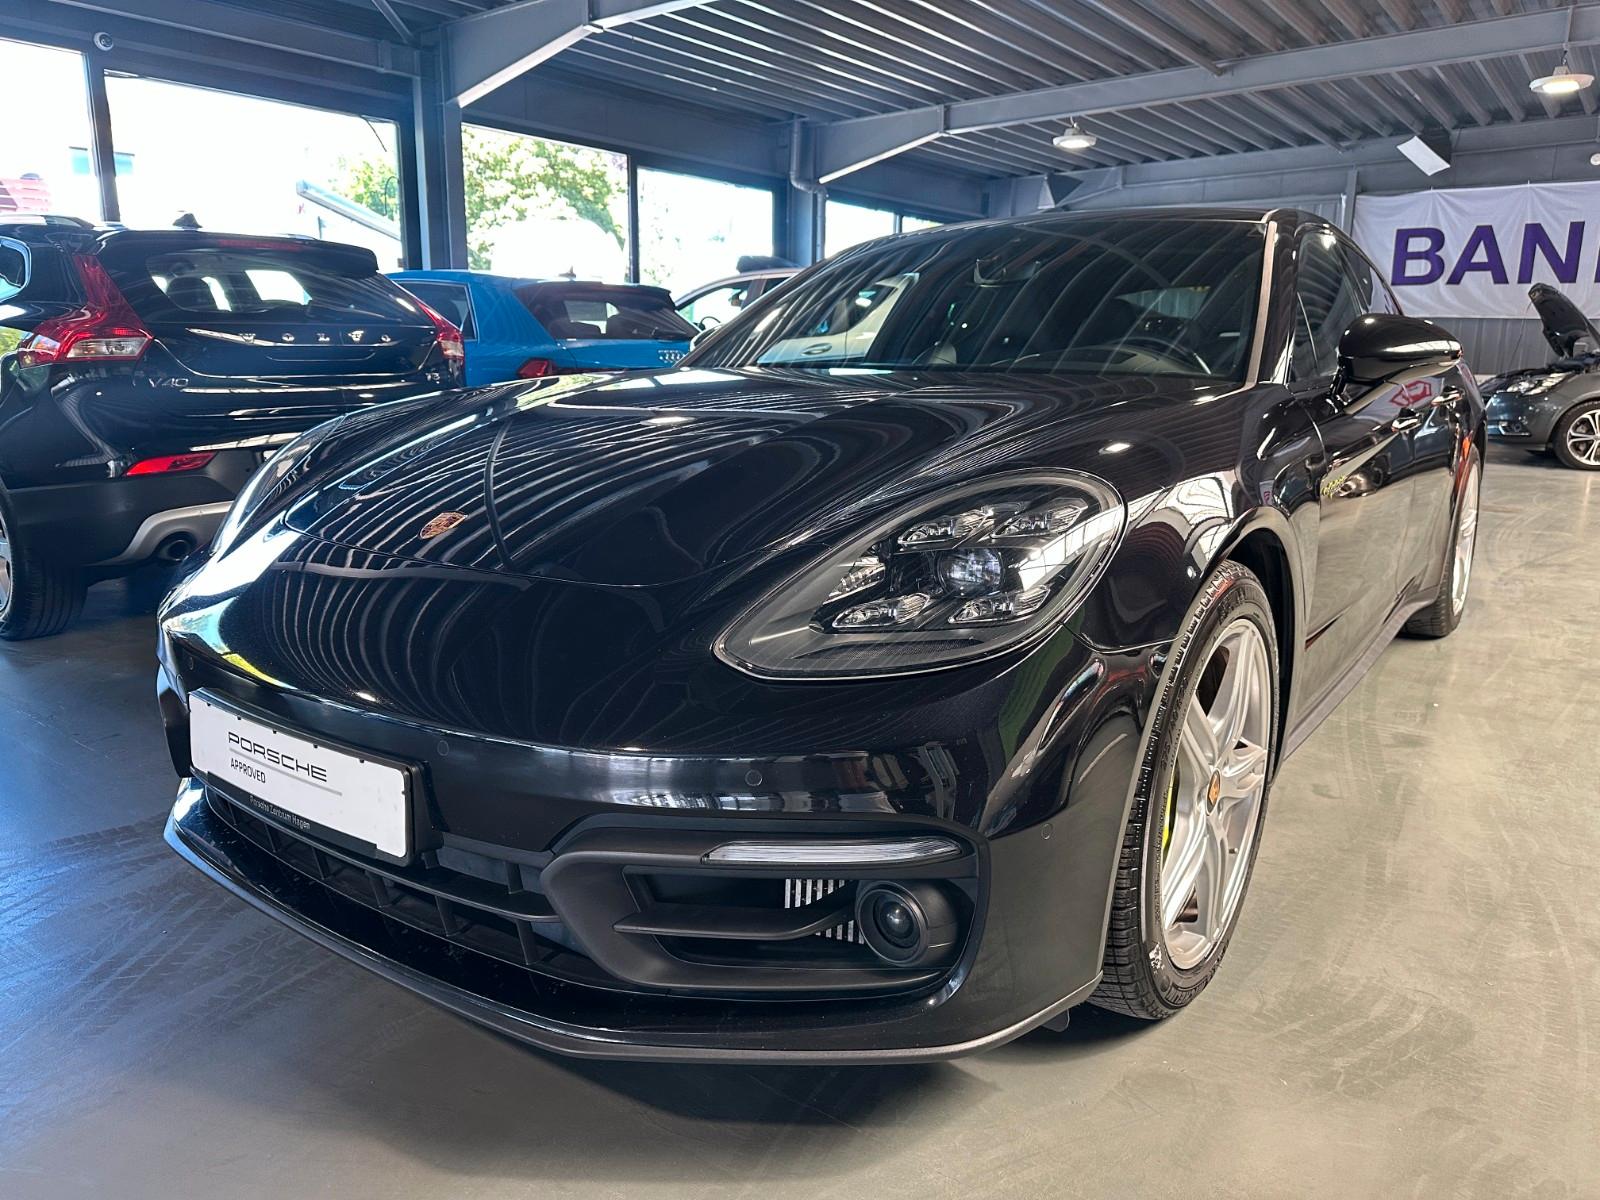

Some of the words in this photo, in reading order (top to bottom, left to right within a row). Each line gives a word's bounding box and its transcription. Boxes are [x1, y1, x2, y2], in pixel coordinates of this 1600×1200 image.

[1391, 220, 1600, 286] BAN
[148, 377, 189, 388] V40
[228, 731, 327, 783] PORSCHE
[230, 757, 266, 784] APPROVED
